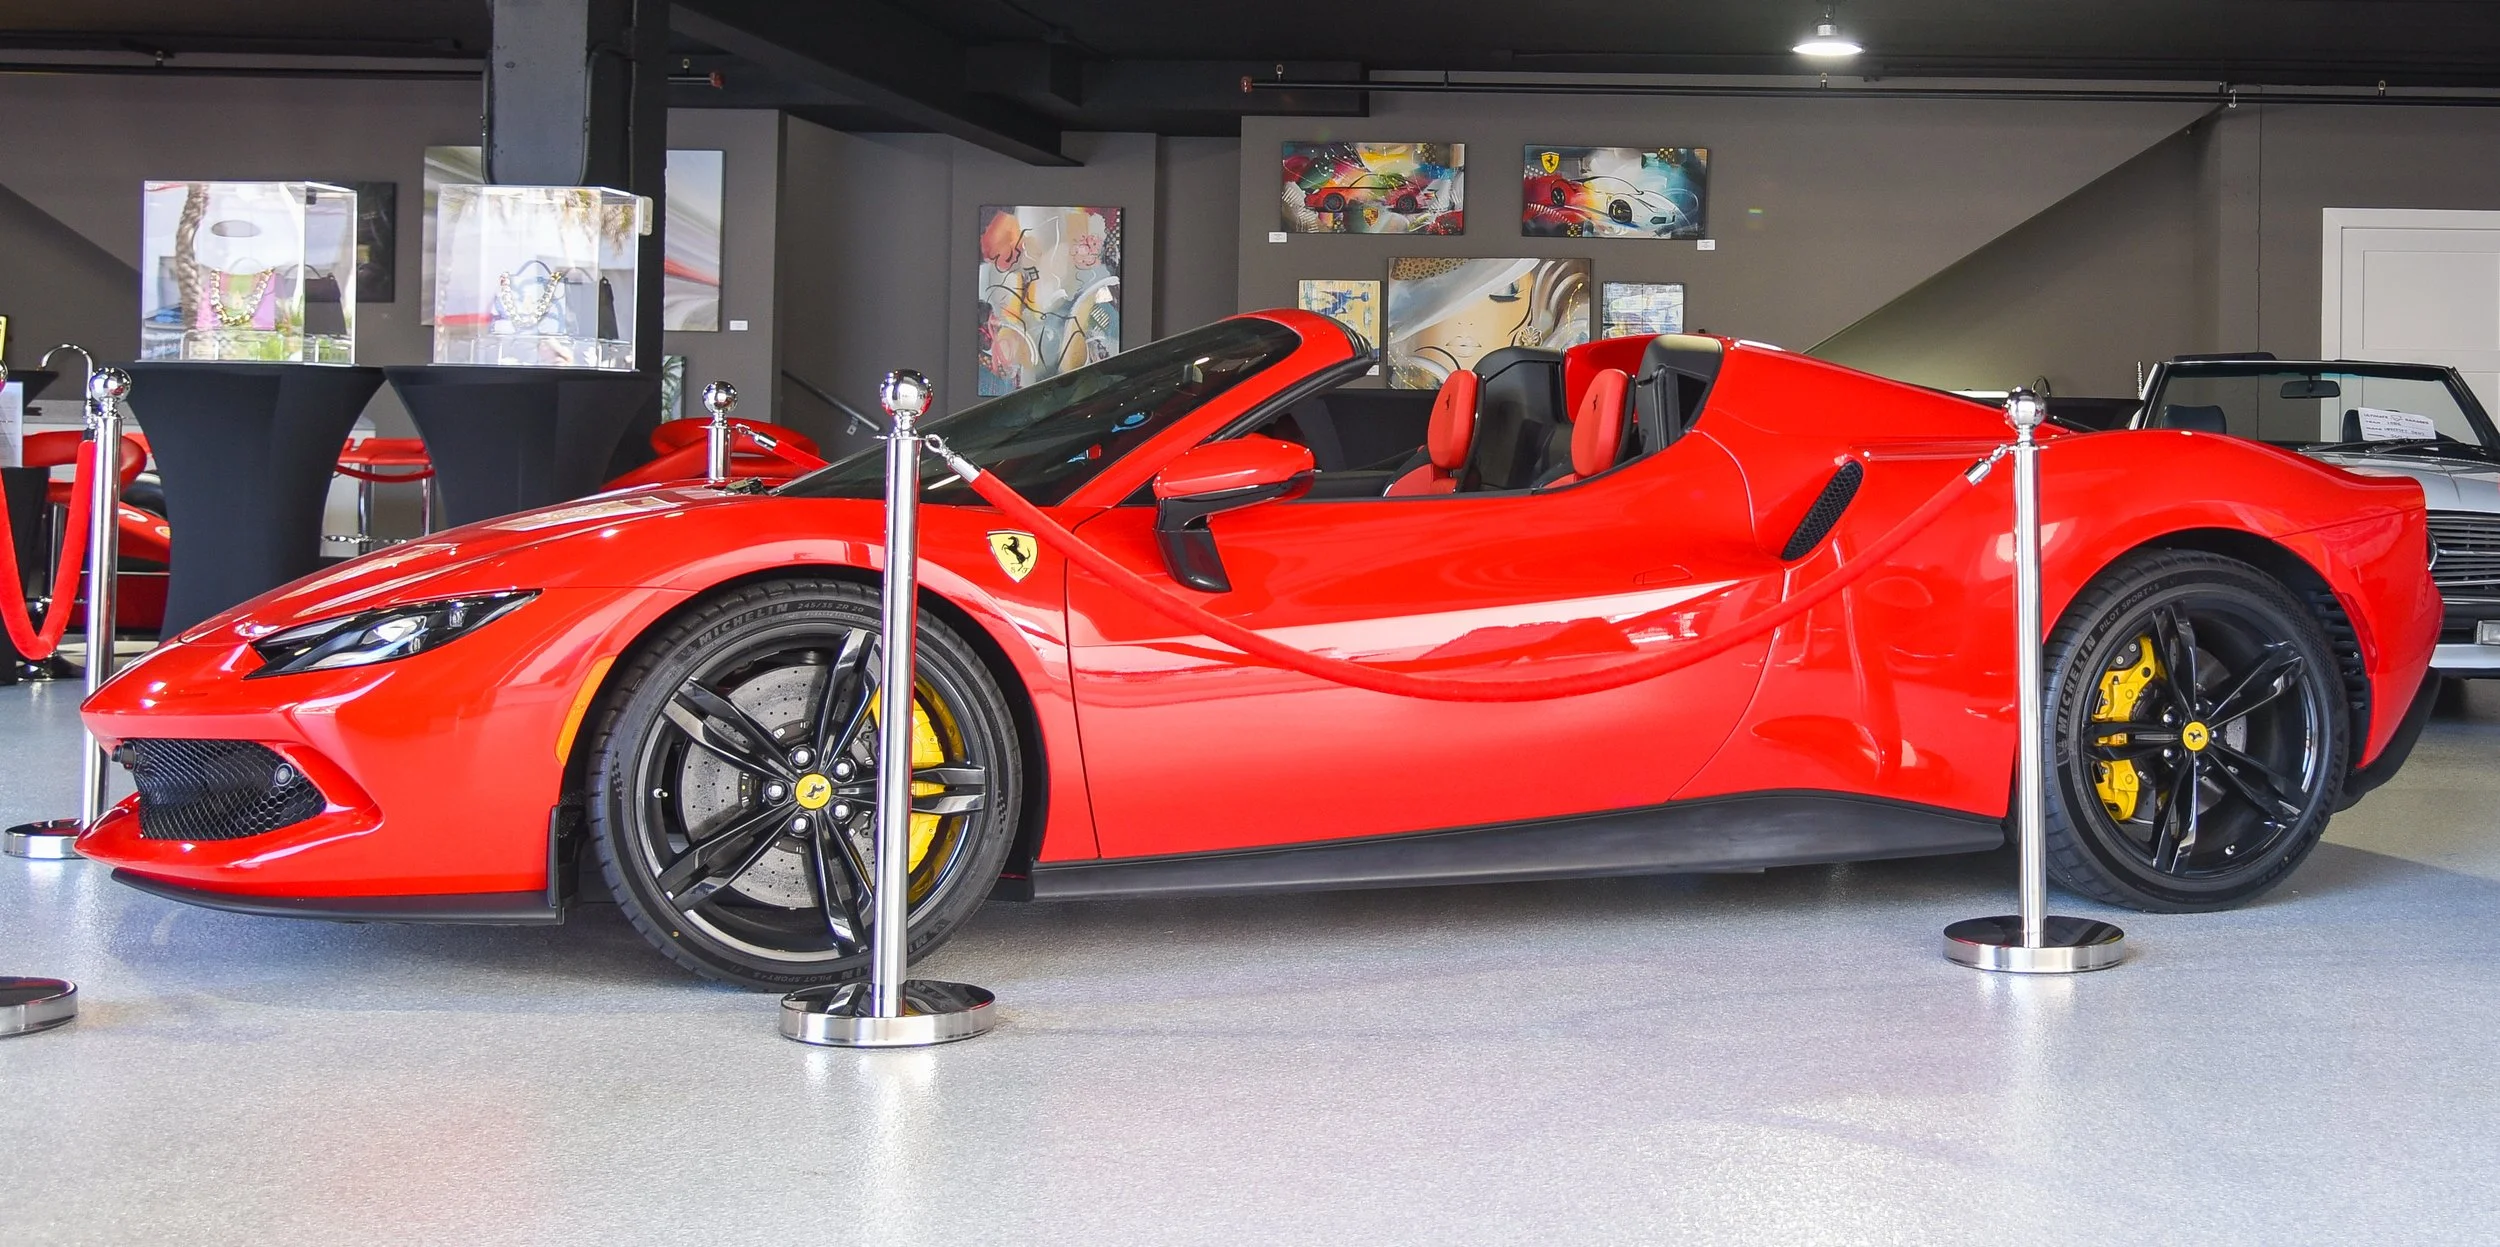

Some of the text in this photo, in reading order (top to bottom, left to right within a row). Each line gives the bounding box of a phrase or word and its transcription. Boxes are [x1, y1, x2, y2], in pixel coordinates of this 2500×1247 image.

[699, 603, 789, 646] MICHELIN
[797, 602, 833, 610] 245/35
[835, 603, 850, 611] ZR
[2057, 634, 2096, 734] MICHELIN
[2100, 609, 2120, 632] PILOT
[803, 975, 832, 983] PILOT
